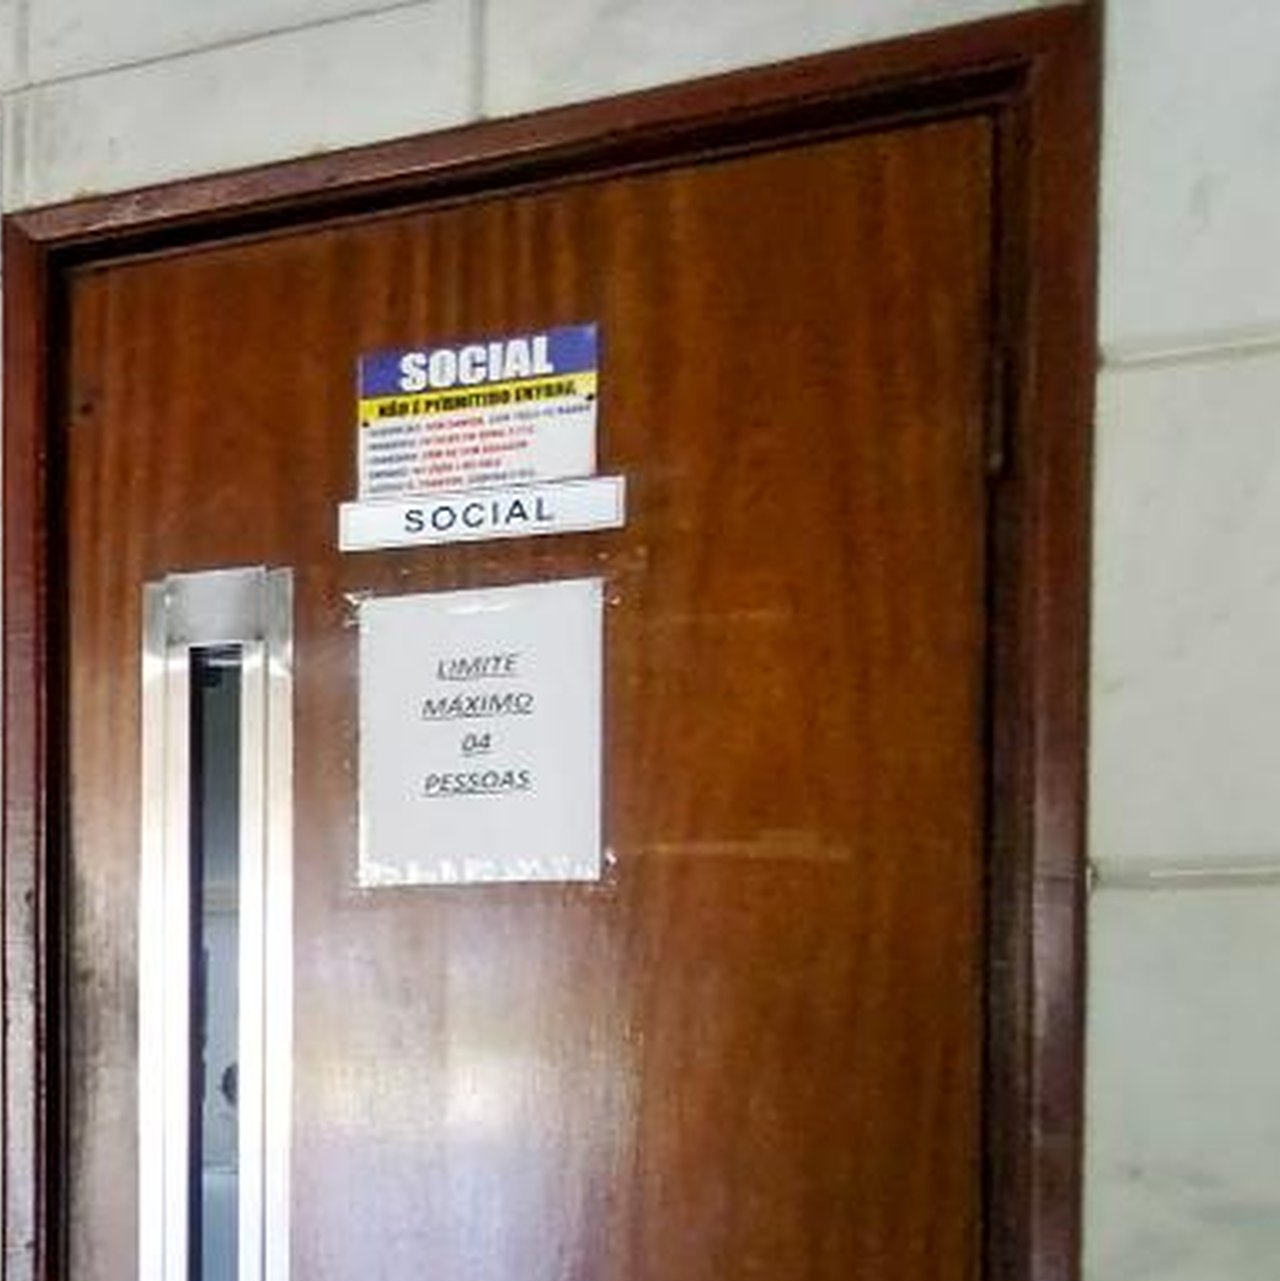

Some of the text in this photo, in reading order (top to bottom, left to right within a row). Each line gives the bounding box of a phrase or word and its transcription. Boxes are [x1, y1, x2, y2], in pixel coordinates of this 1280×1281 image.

[399, 336, 554, 391] SOCIAL
[404, 498, 555, 532] SOCIAL
[437, 652, 520, 680] LIMITE
[422, 692, 534, 719] MÁXIMO
[461, 733, 492, 757] 04
[423, 769, 532, 798] PESSOAS
